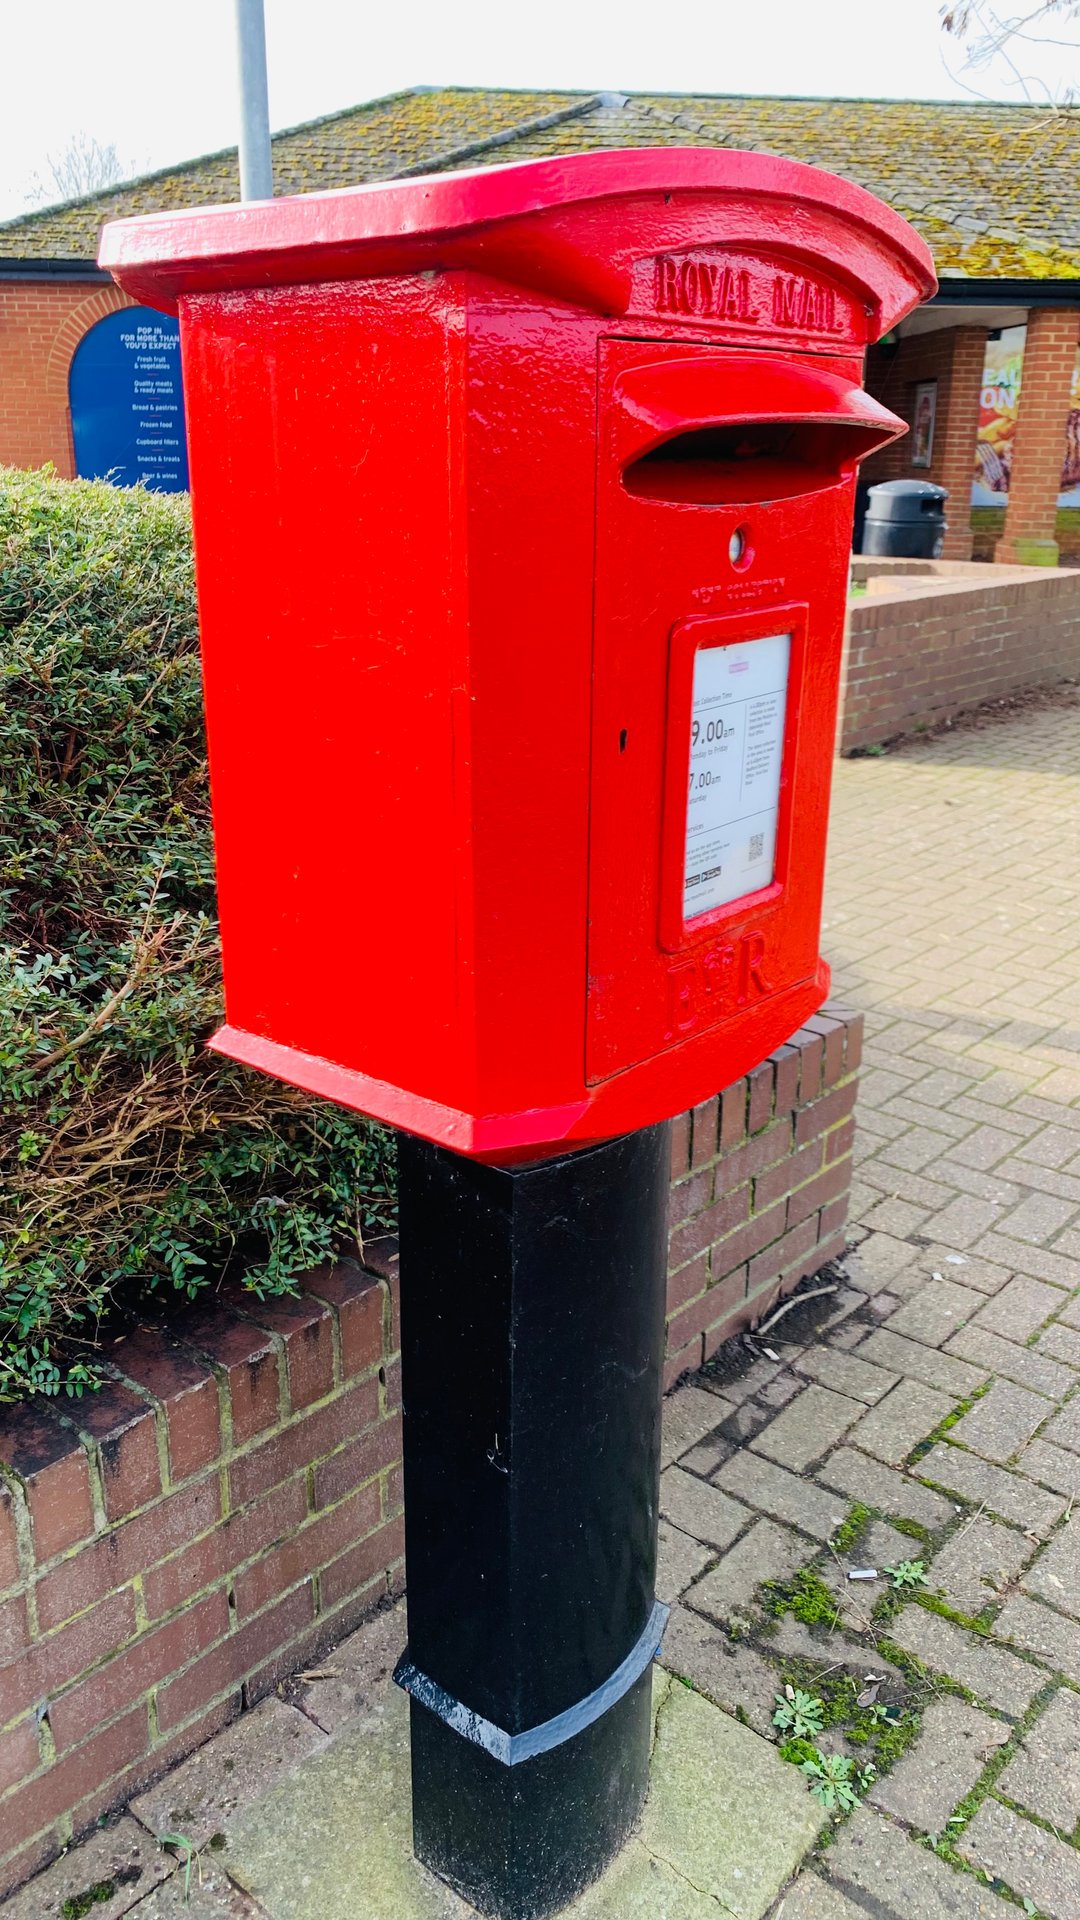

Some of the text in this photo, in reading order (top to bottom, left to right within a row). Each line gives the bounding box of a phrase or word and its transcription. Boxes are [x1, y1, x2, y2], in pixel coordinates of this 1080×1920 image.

[655, 257, 845, 336] ROYAL MAIL
[137, 326, 163, 335] POP IN
[120, 334, 180, 343] FOR MORE THAN
[124, 342, 177, 350] YOU'D EXPECT
[136, 355, 167, 363] Fresh fruit
[134, 362, 139, 370] &
[133, 380, 154, 388] Quality
[133, 386, 139, 394] &
[139, 387, 156, 395] ready
[979, 387, 1015, 409] ON
[140, 421, 173, 429] Frozen food
[135, 438, 179, 446] Cupboard fillers
[136, 455, 181, 463] Snacks & treats
